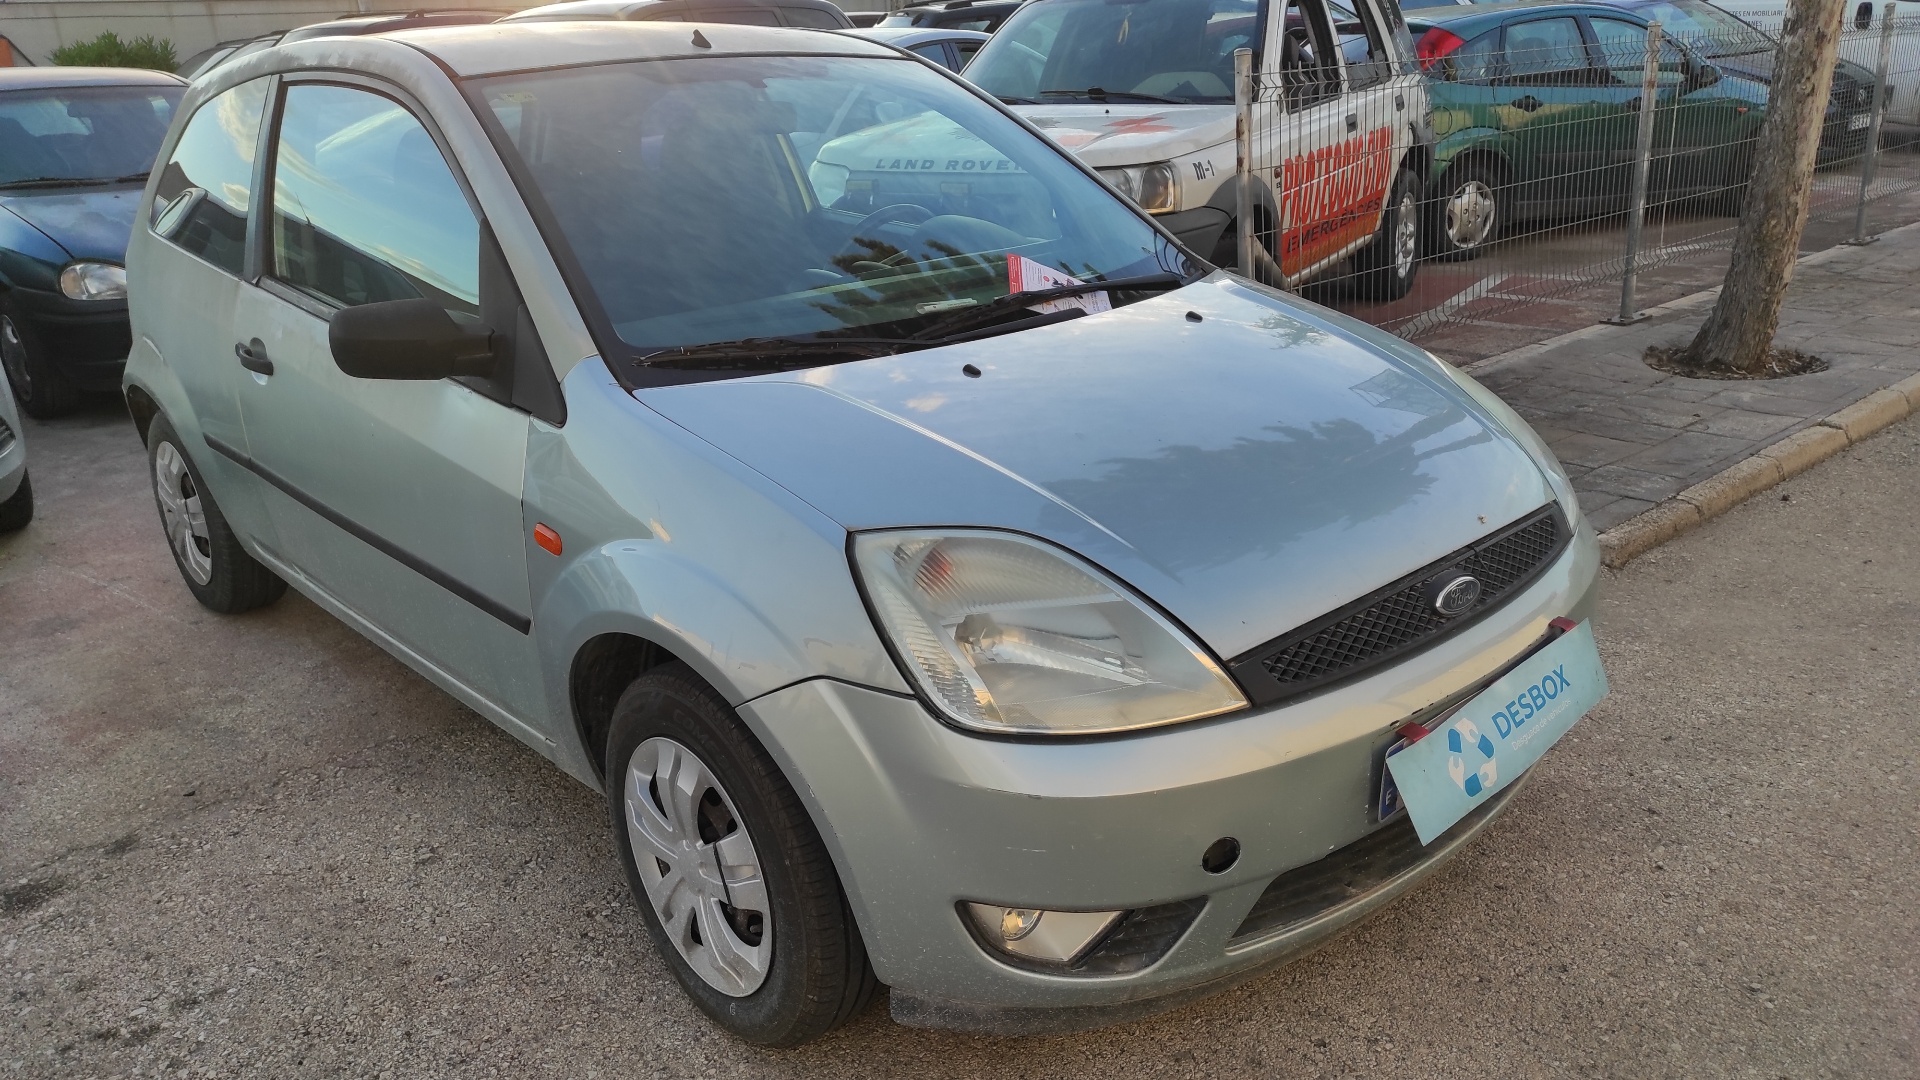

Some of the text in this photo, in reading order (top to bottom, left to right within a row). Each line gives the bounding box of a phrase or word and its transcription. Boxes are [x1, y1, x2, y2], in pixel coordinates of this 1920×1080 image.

[875, 158, 935, 170] LAND
[1192, 159, 1215, 181] M-1
[1450, 583, 1474, 608] Ford
[1491, 663, 1571, 740] DESBOX
[1385, 787, 1394, 806] E
